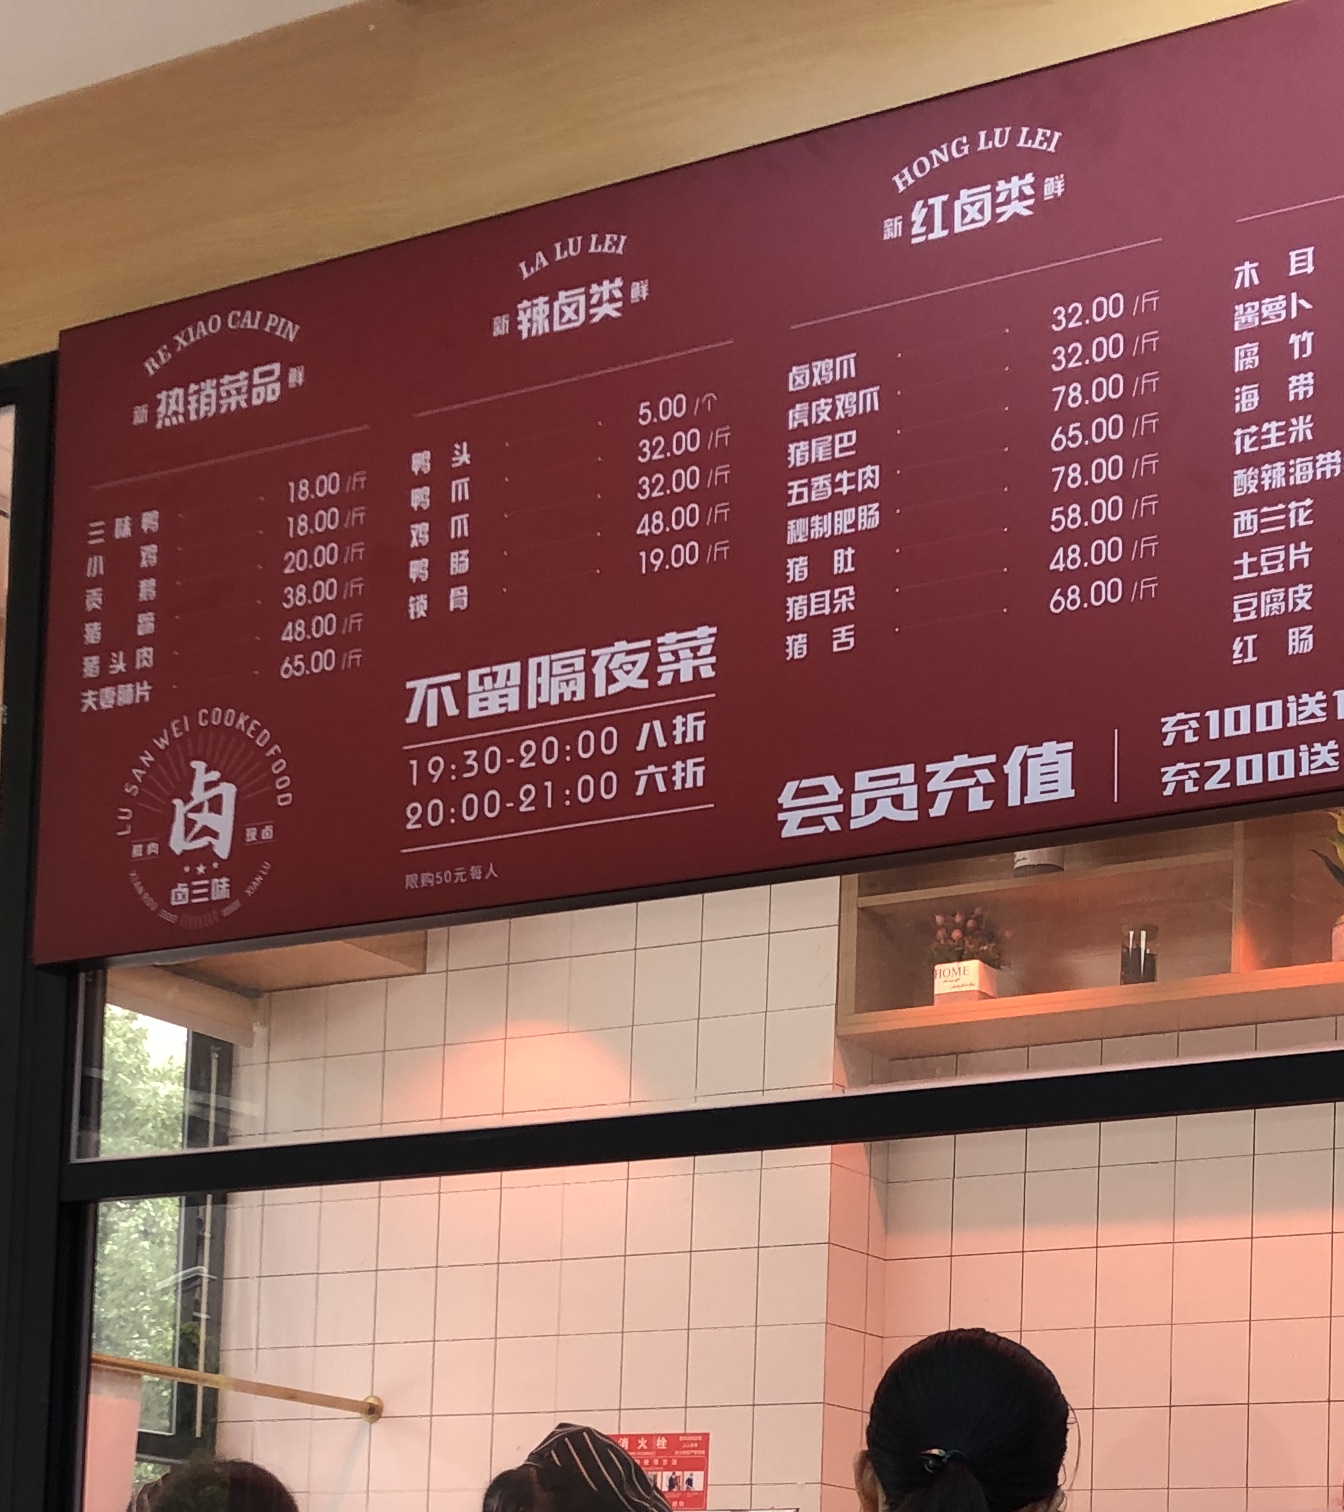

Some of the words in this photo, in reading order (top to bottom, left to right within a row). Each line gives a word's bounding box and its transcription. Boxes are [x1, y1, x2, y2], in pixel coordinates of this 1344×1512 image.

[891, 136, 971, 194] HONG
[977, 126, 1012, 152] LU
[1016, 126, 1063, 154] LEI
[883, 214, 903, 241] 新
[910, 171, 1036, 245] 红卤类
[1043, 173, 1066, 201] 鲜
[518, 251, 549, 280] LA
[554, 236, 582, 262] LU
[588, 233, 628, 255] LEI
[1234, 246, 1316, 291] 木耳
[516, 276, 624, 341] 辣卤类
[1234, 291, 1314, 332] 酱萝卜
[143, 344, 172, 376] RE
[172, 313, 222, 352] XIAO
[227, 309, 263, 331] CAI
[264, 313, 301, 342] PIN
[1234, 330, 1314, 374] 腐竹
[788, 352, 857, 393] 卤鸡爪
[1234, 372, 1316, 415] 海带
[155, 362, 281, 430] 热销菜品
[788, 386, 880, 430] 虎皮鸡爪
[787, 430, 857, 470] 猪尾巴
[1233, 413, 1315, 456] 花生米
[787, 464, 880, 507] 五香牛肉
[786, 502, 880, 546] 秘制肥肠
[1232, 498, 1314, 539] 西兰花
[786, 546, 856, 584] 猪肚
[1232, 540, 1314, 582] 土豆片
[785, 586, 856, 623] 猪耳朵
[1232, 583, 1314, 623] 豆腐皮
[785, 624, 856, 662] 猪舌
[1232, 624, 1315, 666] 红肠
[404, 624, 718, 727] 不留隔夜菜
[124, 749, 156, 797] SAN
[152, 714, 190, 750] WEI
[408, 726, 619, 787] 19:30-20:00
[635, 711, 706, 752] 八折
[405, 771, 619, 830] 20:00-21:00
[634, 756, 705, 796] 六折
[776, 740, 1076, 839] 会员充值
[934, 966, 969, 979] HOME
